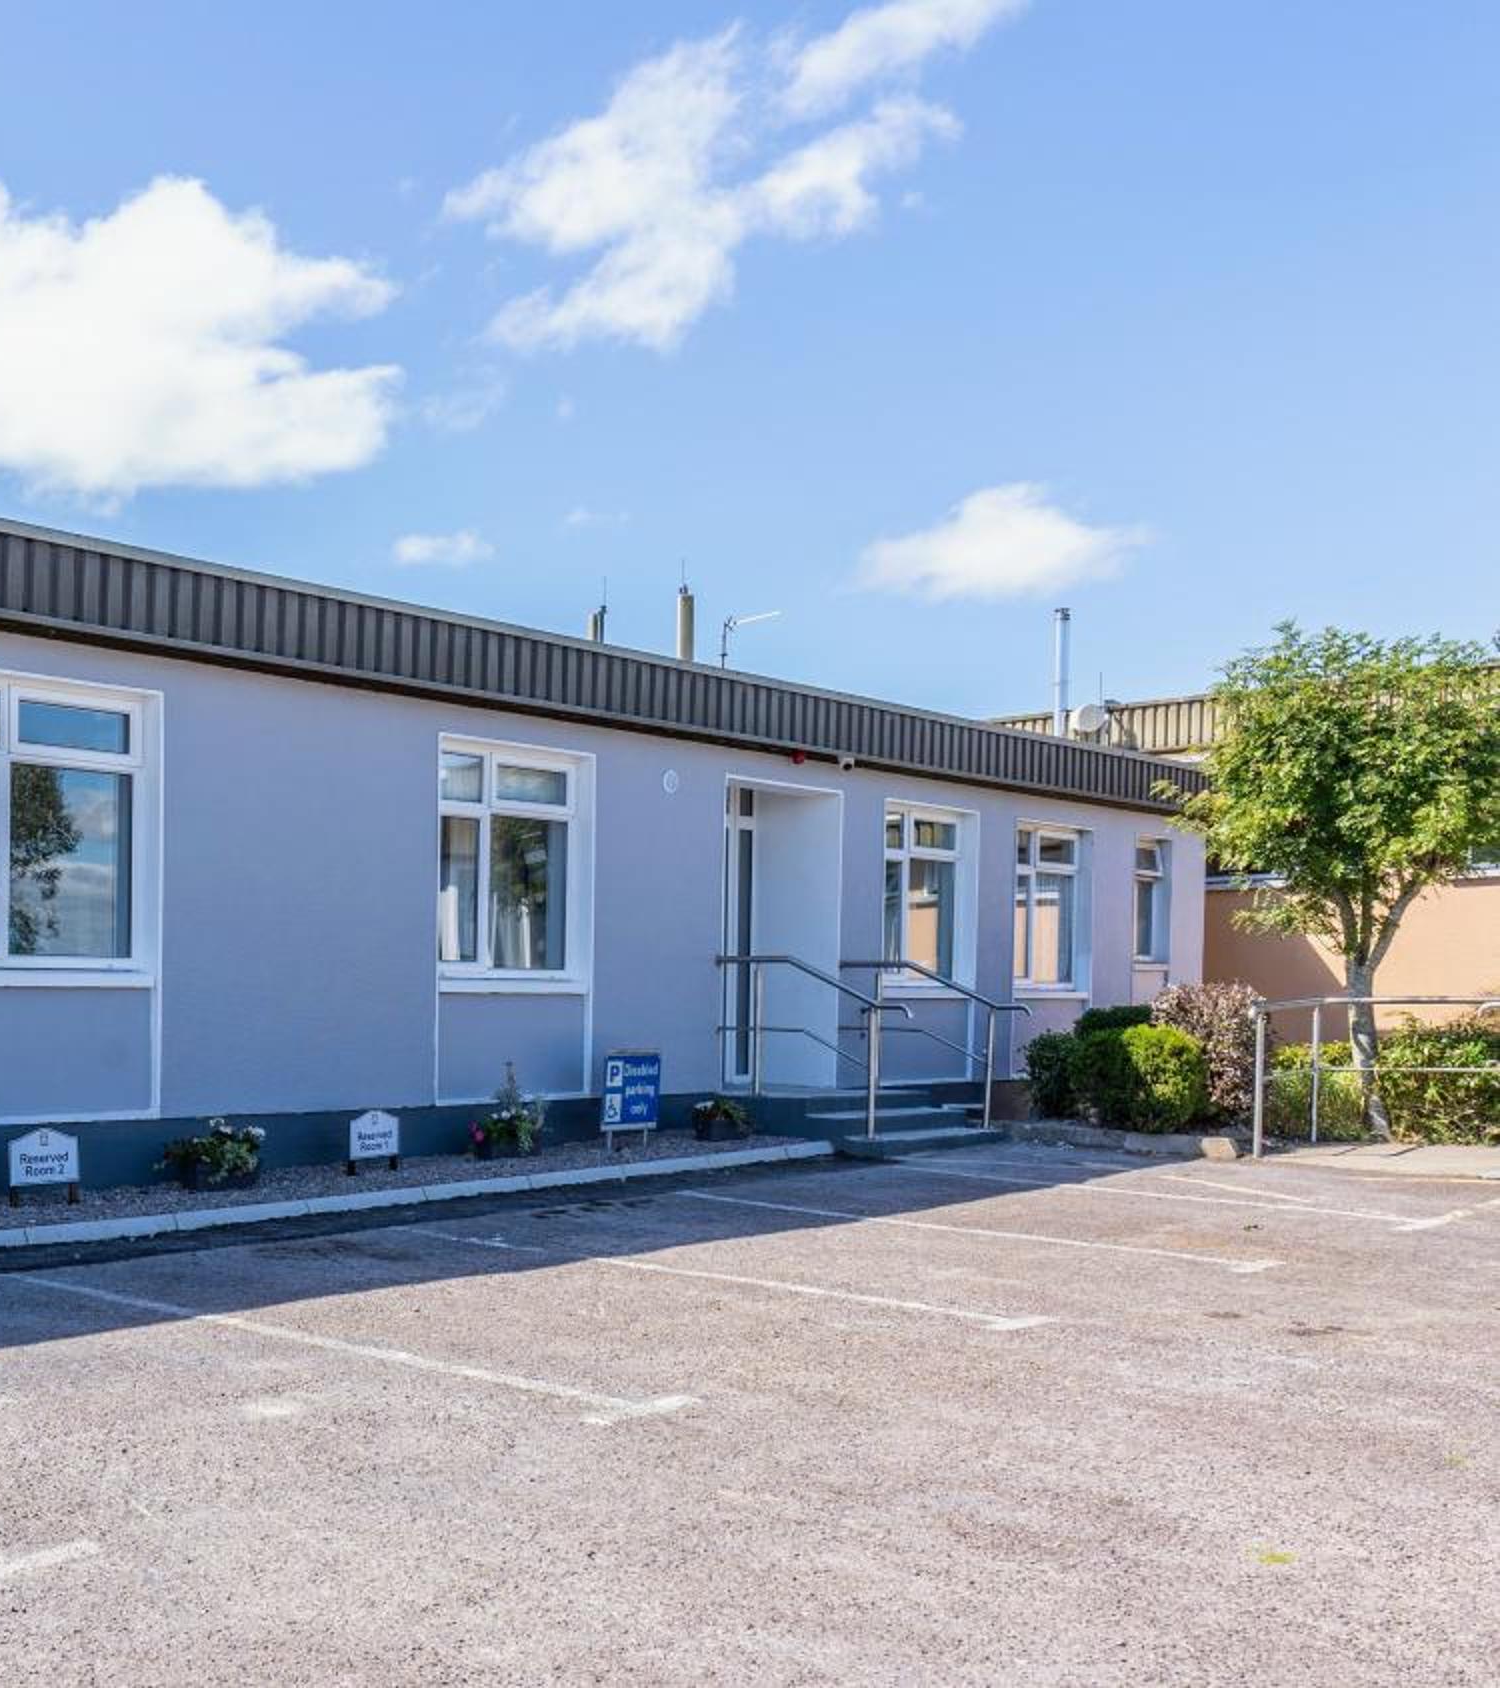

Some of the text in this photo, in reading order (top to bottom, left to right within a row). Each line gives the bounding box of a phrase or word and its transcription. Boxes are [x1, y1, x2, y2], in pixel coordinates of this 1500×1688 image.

[610, 1065, 620, 1083] P
[20, 1152, 69, 1165] Reserved
[25, 1163, 65, 1177] Room 2
